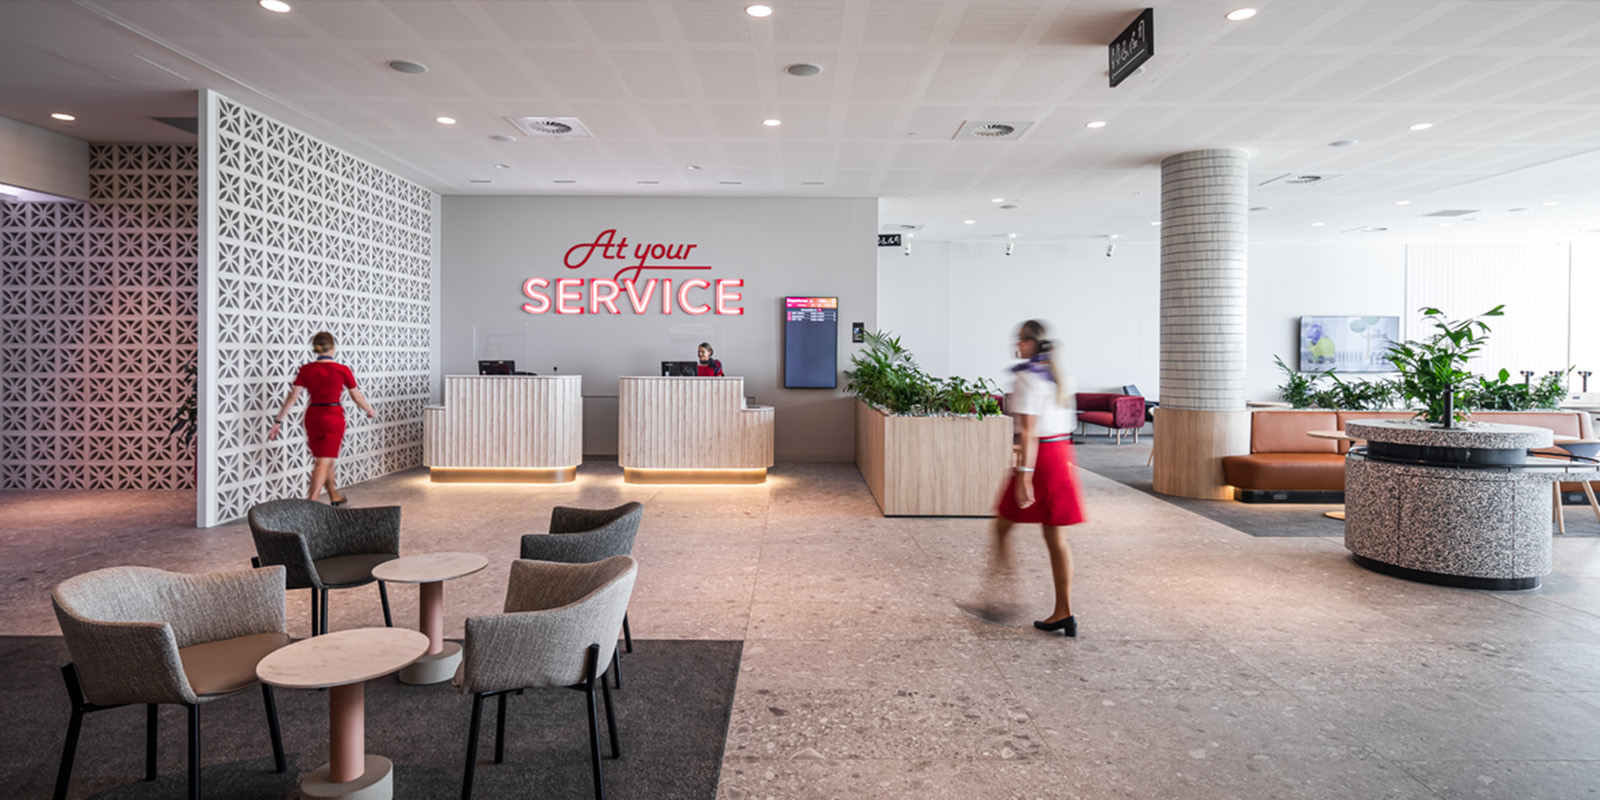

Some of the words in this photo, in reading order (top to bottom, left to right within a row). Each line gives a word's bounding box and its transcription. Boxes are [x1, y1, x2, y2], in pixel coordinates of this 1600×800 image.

[563, 229, 628, 269] At
[614, 243, 712, 292] your
[522, 277, 744, 315] SERVICE
